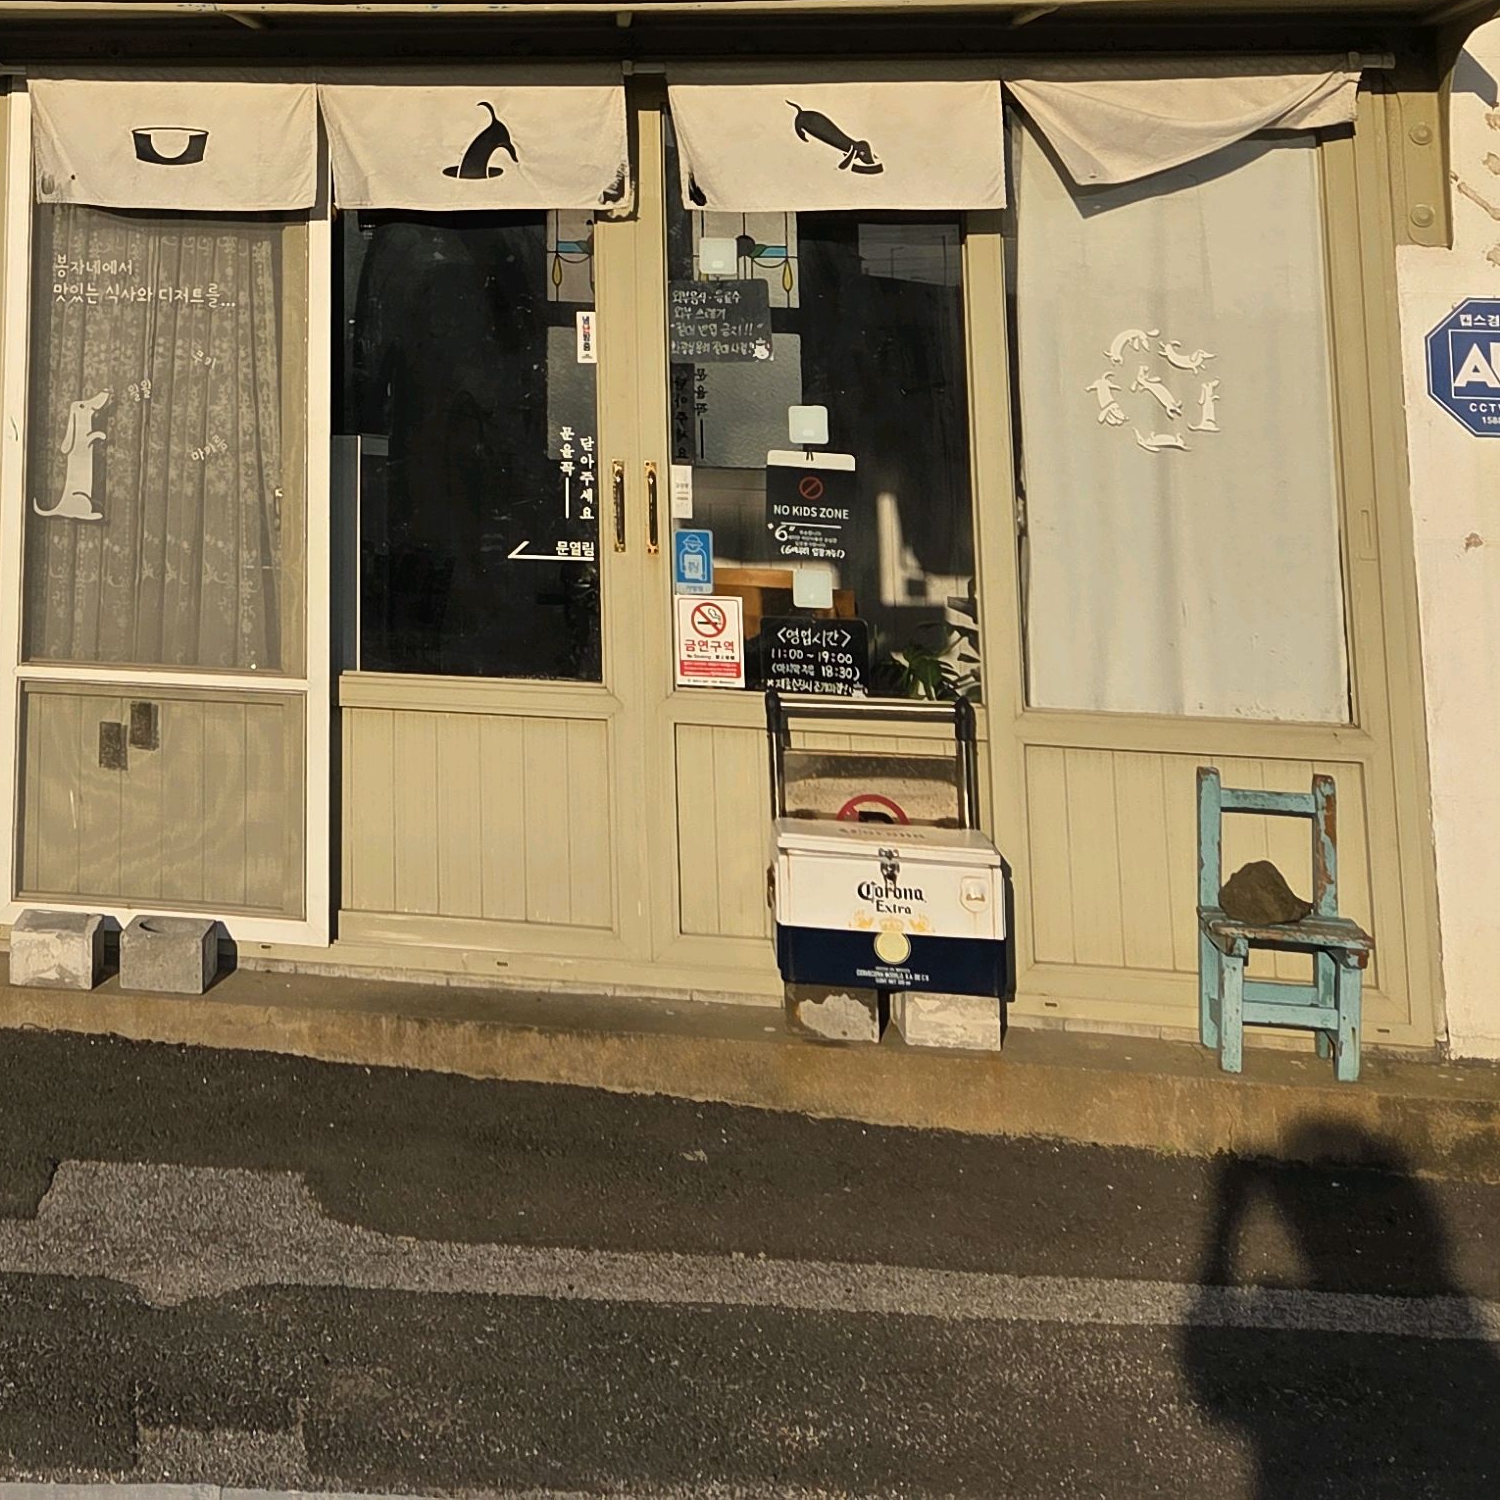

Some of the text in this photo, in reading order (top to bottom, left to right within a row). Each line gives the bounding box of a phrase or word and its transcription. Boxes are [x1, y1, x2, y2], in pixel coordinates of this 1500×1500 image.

[54, 253, 133, 278] 봉자네에서
[53, 283, 100, 304] 맛있는
[105, 283, 153, 304] 식사와
[1469, 402, 1500, 413] CCT
[579, 436, 595, 520] 닫아주세요
[773, 504, 850, 520] NO KIDS ZONE
[555, 541, 595, 557] 문열림
[684, 638, 735, 653] 금연구역
[818, 650, 853, 664] 19:00
[857, 880, 925, 903] Corona
[875, 900, 912, 915] Extra
